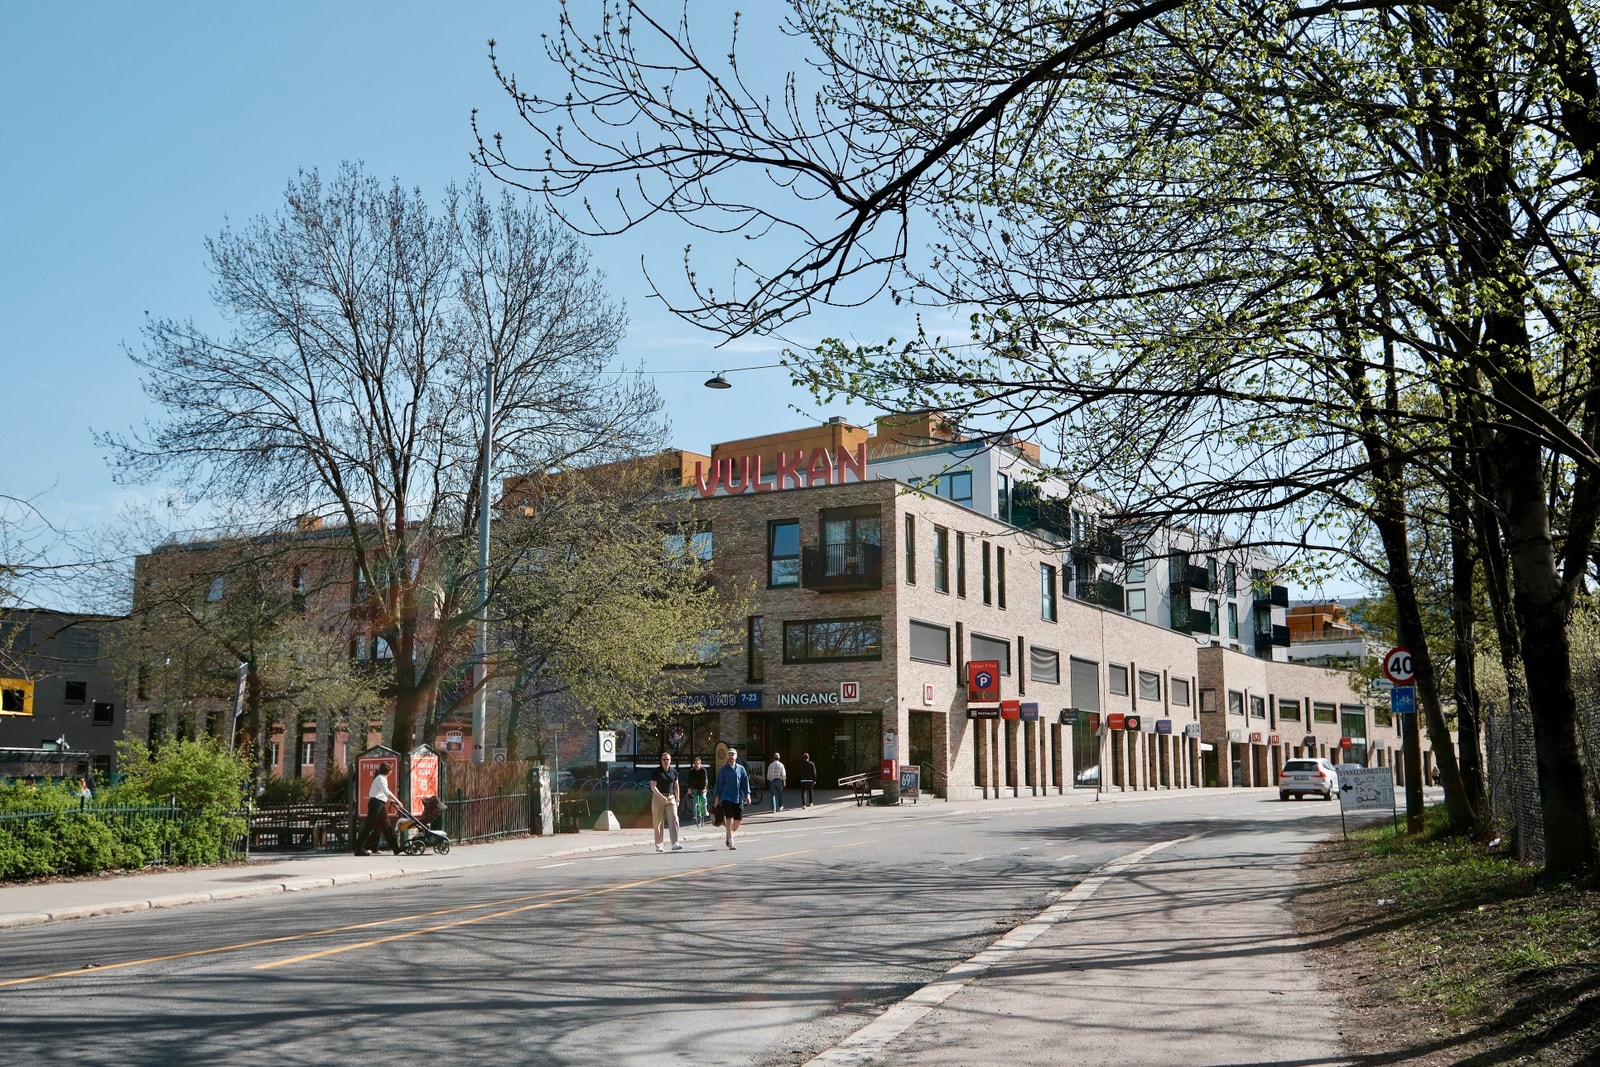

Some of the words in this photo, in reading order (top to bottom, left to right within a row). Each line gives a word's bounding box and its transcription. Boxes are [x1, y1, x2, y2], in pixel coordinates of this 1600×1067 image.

[695, 443, 867, 497] VULKAN
[1390, 656, 1414, 674] 40
[709, 694, 737, 706] 1000
[742, 694, 757, 702] 7-23
[777, 693, 838, 705] INNGANG
[1338, 768, 1390, 777] SYKKELVERKSTED
[901, 774, 911, 786] 69
